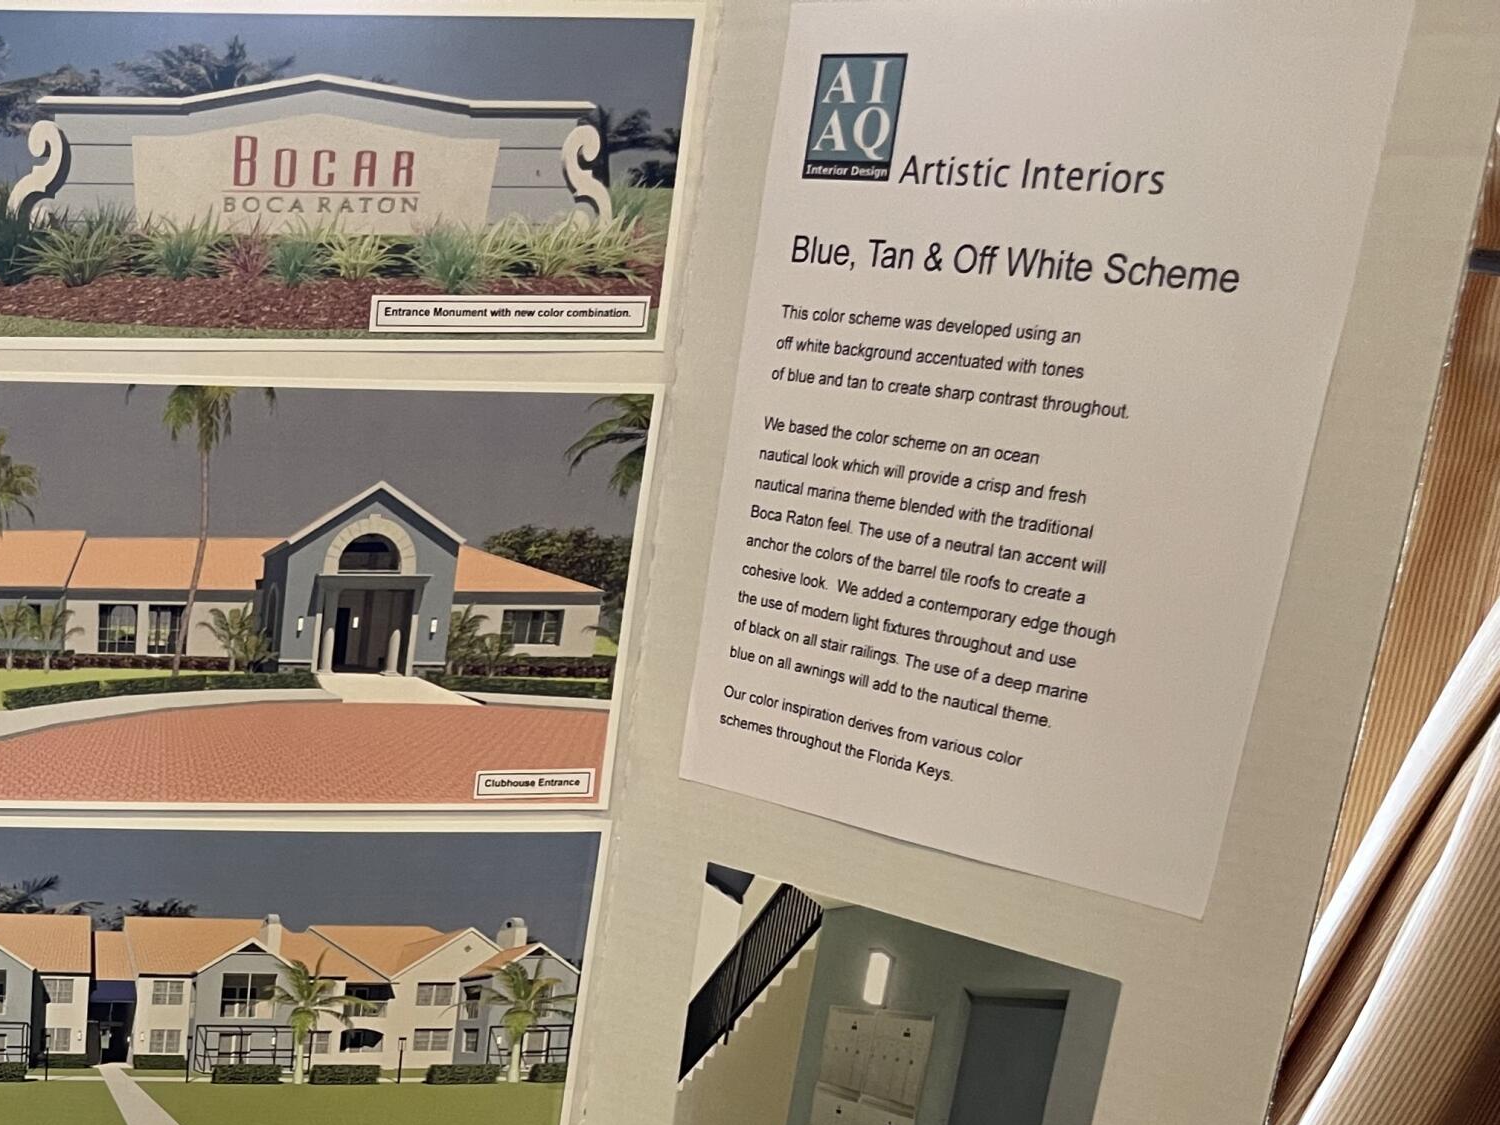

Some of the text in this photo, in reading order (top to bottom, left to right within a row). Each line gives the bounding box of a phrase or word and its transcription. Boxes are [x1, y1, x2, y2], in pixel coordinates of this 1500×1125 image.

[232, 135, 415, 188] BOCAR
[806, 164, 888, 178] Interior Design
[898, 155, 1165, 195] Artistic Interiors
[223, 196, 420, 214] BOCA RATON
[791, 235, 1239, 293] Blue, Tan & Off White Scheme
[384, 306, 430, 317] Entrance
[433, 307, 487, 317] Monument
[490, 308, 511, 317] with
[537, 308, 564, 317] color
[566, 308, 631, 318] combination.
[782, 304, 1081, 346] This color scheme was developed using an
[776, 336, 1084, 379] off white background accentuated with tones
[771, 367, 786, 380] of
[787, 368, 815, 384] blue
[818, 373, 844, 387] and
[847, 375, 867, 389] tan
[871, 377, 884, 391] to
[888, 382, 931, 397] create
[935, 384, 975, 404] sharp
[979, 391, 1038, 409] contrast
[759, 449, 1087, 504] nautical look which will provide a crisp and fresh
[724, 685, 1023, 766] Our color inspiration derives from various color
[720, 714, 953, 782] schemes throughout the Florida Keys.
[484, 778, 580, 787] Clubhouse Entrance
